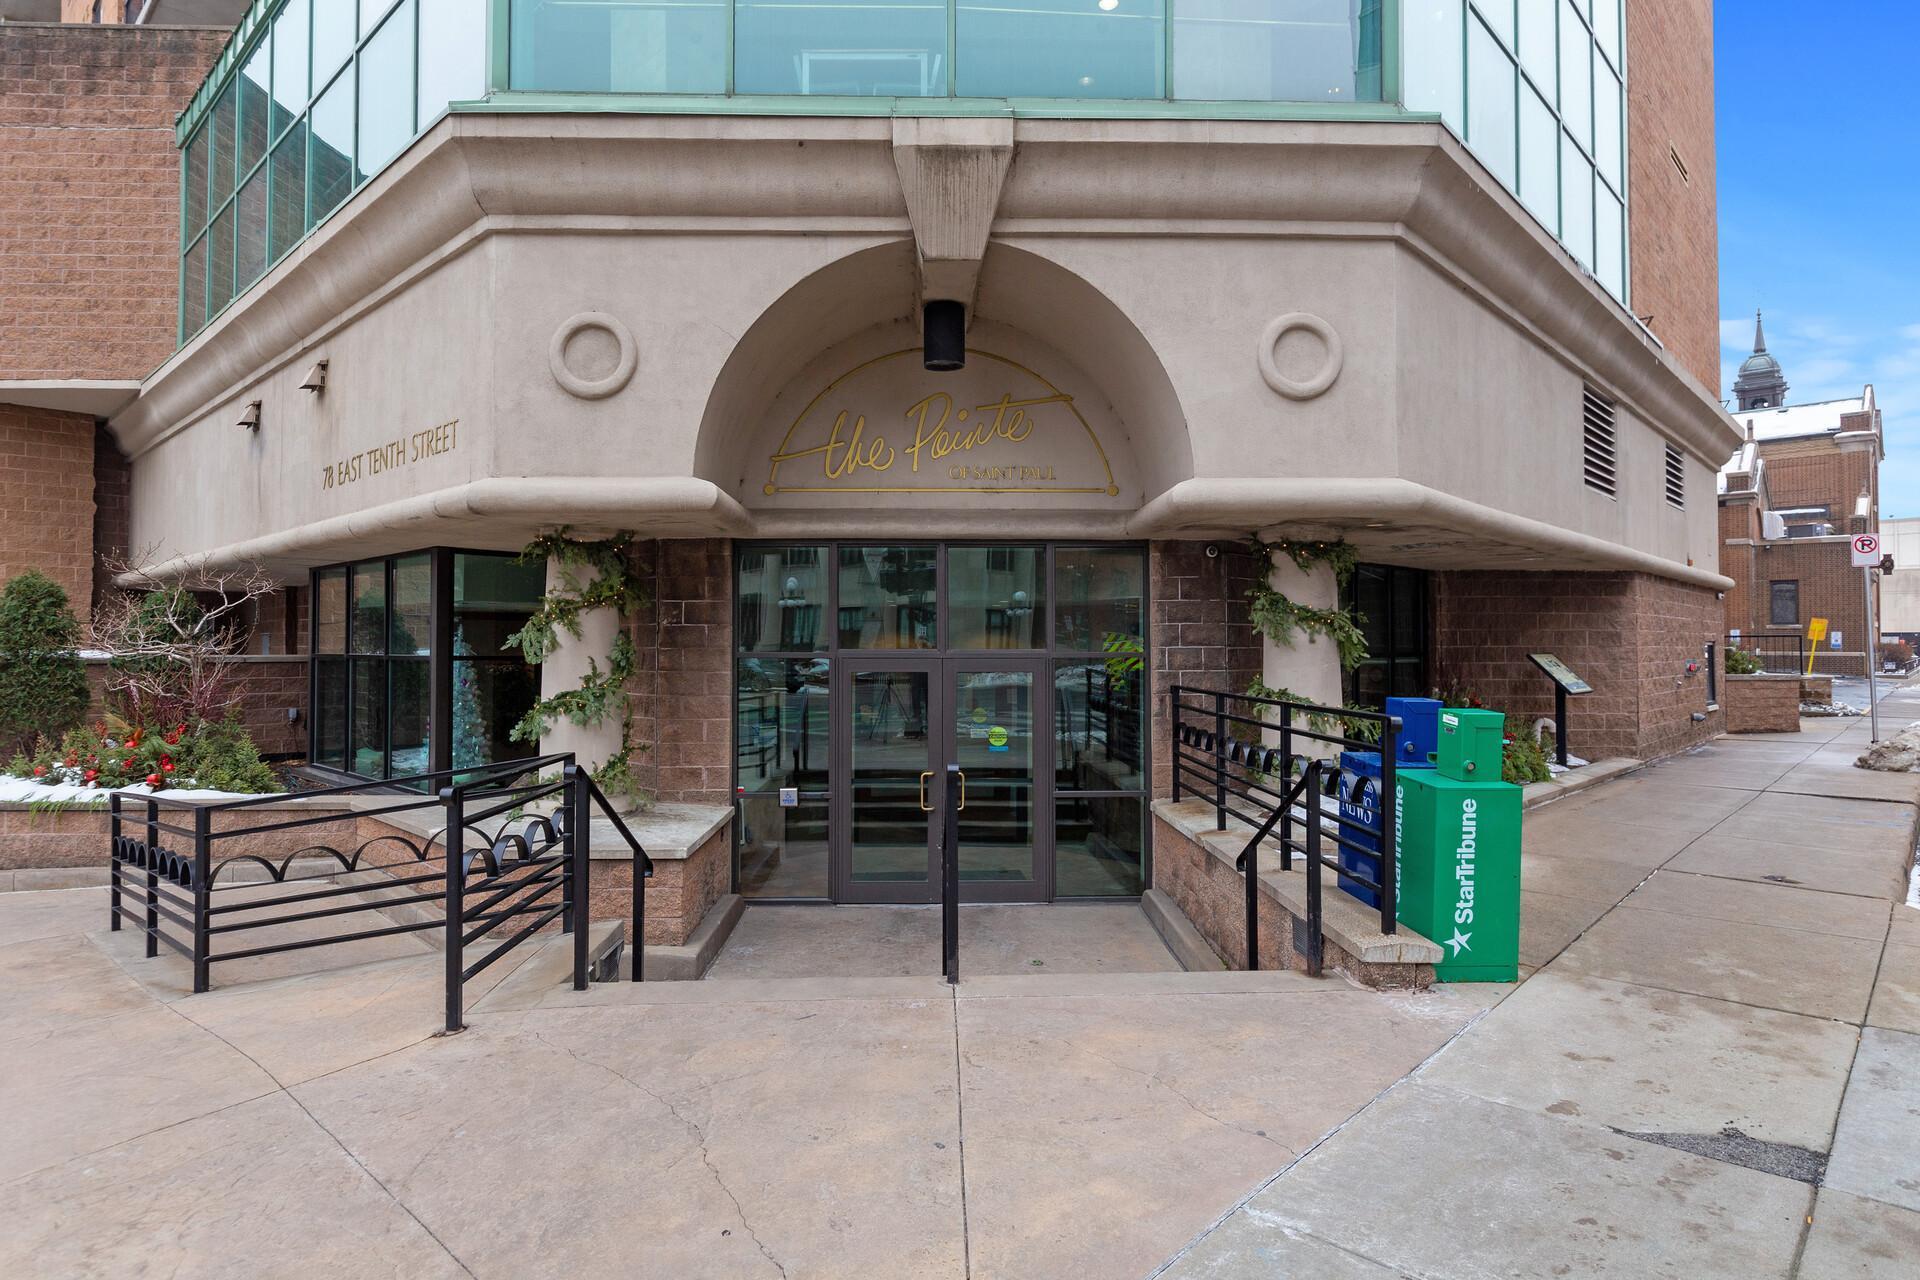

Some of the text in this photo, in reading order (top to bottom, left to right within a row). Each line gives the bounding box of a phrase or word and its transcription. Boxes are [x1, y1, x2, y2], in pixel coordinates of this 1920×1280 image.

[322, 419, 459, 490] 78 EAST TENTH STREET
[771, 391, 1074, 480] the Pointe
[948, 464, 1056, 480] OF SAINT PAUL
[1454, 798, 1477, 924] StarTribune
